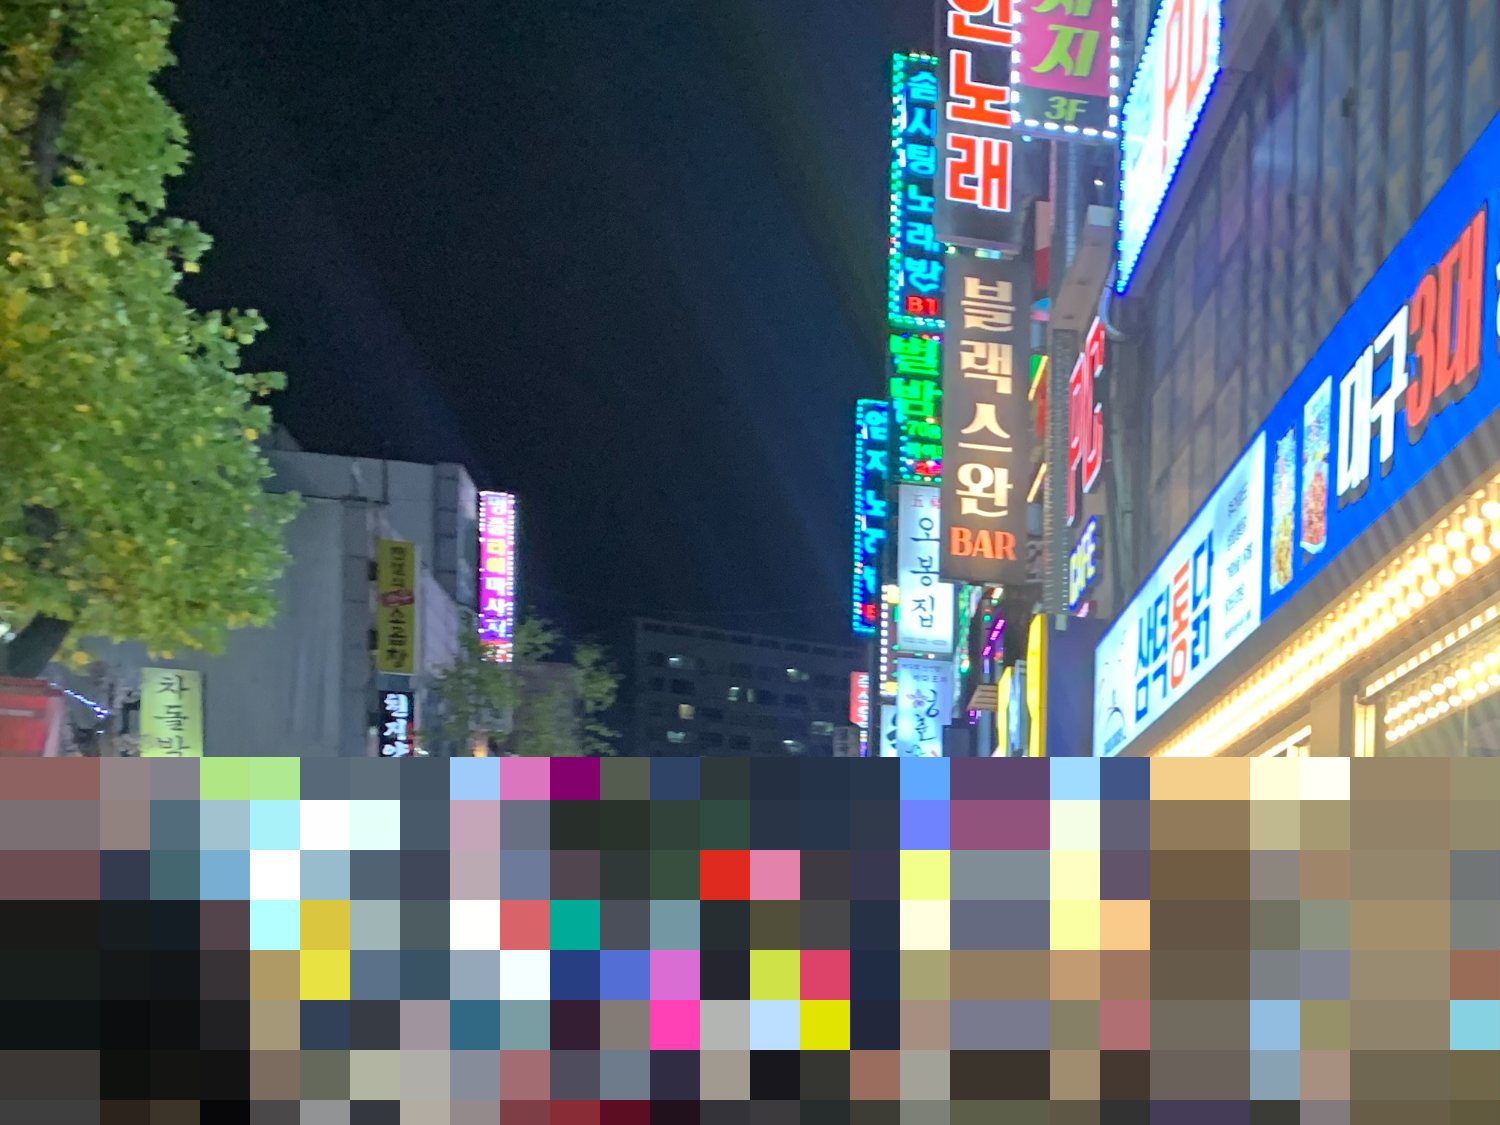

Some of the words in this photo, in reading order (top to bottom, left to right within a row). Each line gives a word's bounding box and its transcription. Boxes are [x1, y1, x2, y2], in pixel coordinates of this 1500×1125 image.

[1044, 96, 1088, 122] 3F
[906, 296, 938, 315] B1
[955, 276, 1016, 518] 블랙스완
[909, 517, 941, 628] 오봉집
[950, 526, 1017, 560] BAR
[1135, 528, 1214, 724] 삼덕통닭
